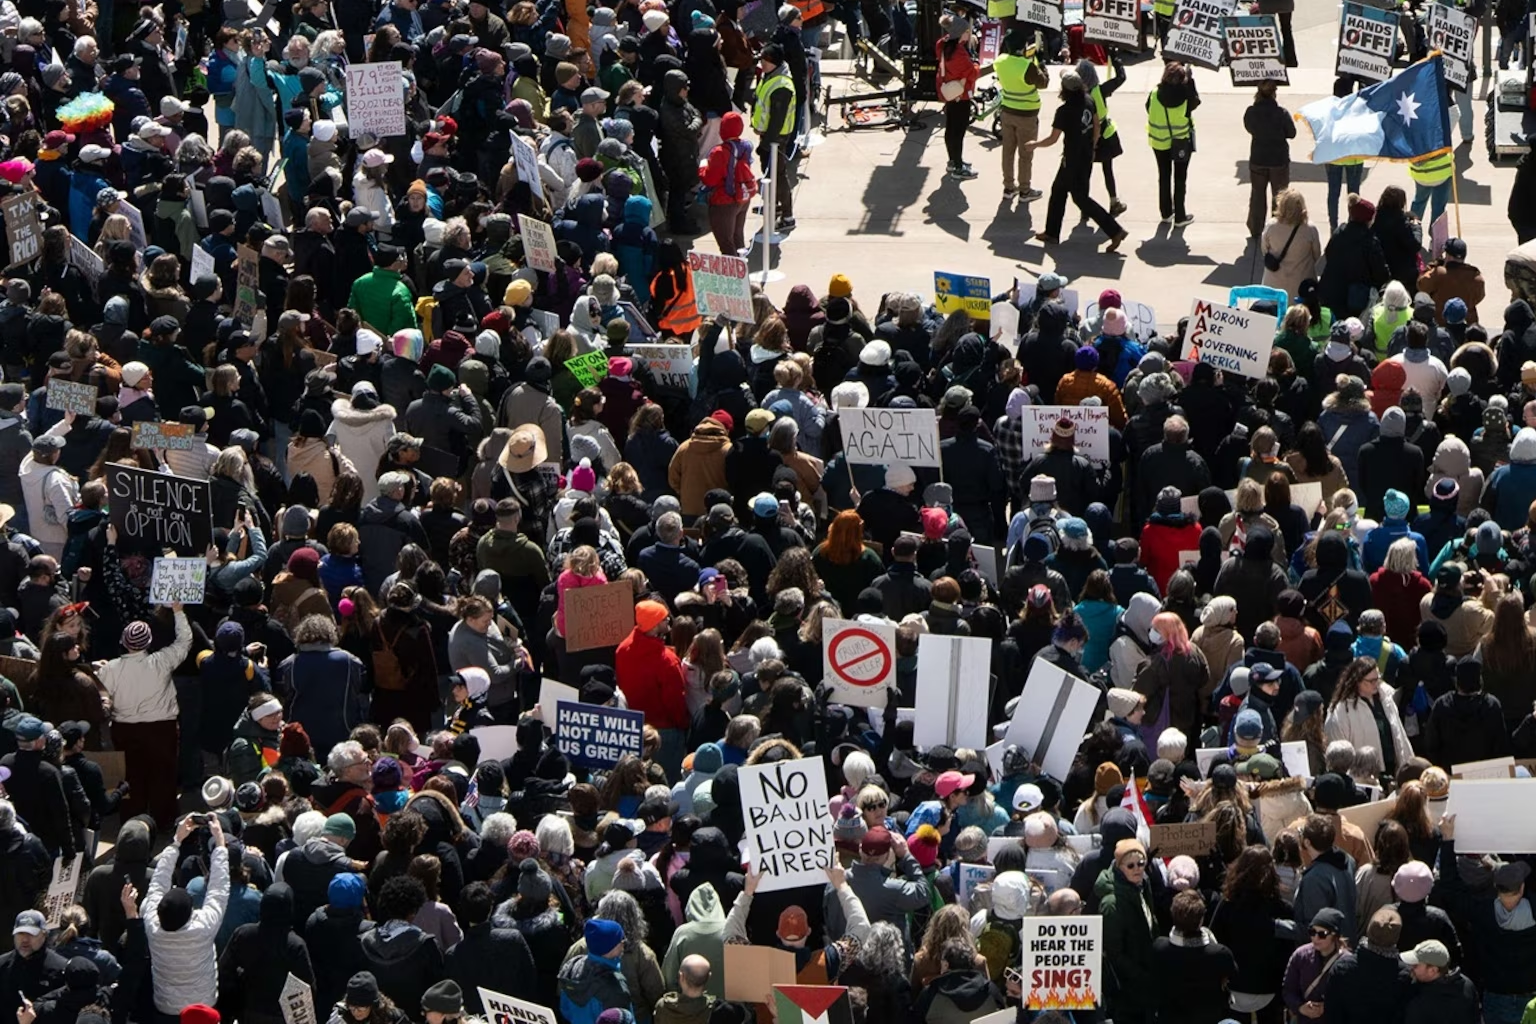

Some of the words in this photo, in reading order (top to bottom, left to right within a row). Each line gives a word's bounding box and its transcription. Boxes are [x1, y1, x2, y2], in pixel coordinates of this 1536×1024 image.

[1027, 11, 1051, 25] BODIES
[1031, 3, 1046, 14] OUR
[1103, 21, 1119, 31] OUR
[1179, 9, 1222, 33] OFF!
[1347, 17, 1392, 36] HANDS
[1435, 18, 1470, 39] HANDS
[1179, 32, 1213, 50] FEDERAL
[1228, 28, 1273, 39] HANDS
[1343, 29, 1391, 55] OFF!
[1174, 41, 1214, 60] WORKERS
[1235, 69, 1258, 78] PUBLIC
[1258, 69, 1284, 79] LANDS
[1248, 61, 1265, 71] OUR
[1341, 56, 1388, 76] IMMIGRANTS
[9, 197, 35, 218] TAX
[13, 225, 32, 240] THE
[13, 234, 39, 264] RICH
[689, 253, 747, 279] DEMAND
[965, 277, 989, 288] STAND
[1193, 300, 1249, 329] MORONS
[1193, 316, 1223, 336] ARE
[1190, 331, 1258, 362] GOVERNING
[569, 356, 587, 369] NOT
[588, 352, 605, 364] ON
[1187, 346, 1242, 372] AMERICA
[863, 410, 911, 431] NOT
[846, 431, 935, 460] AGAIN
[112, 471, 203, 514] SILENCE
[124, 511, 193, 549] OPTION
[560, 709, 601, 728] HATE
[604, 716, 640, 734] WILL
[559, 724, 595, 742] NOT
[597, 730, 641, 749] MAKE
[757, 765, 809, 805] NO
[748, 799, 829, 829] BAJIL-
[755, 830, 832, 854] LION-
[1038, 924, 1058, 937] DO
[1060, 924, 1088, 937] YOU
[1030, 939, 1067, 952] HEAR
[1069, 939, 1095, 952] THE
[1035, 954, 1085, 967] PEOPLE
[1031, 969, 1092, 989] SING?
